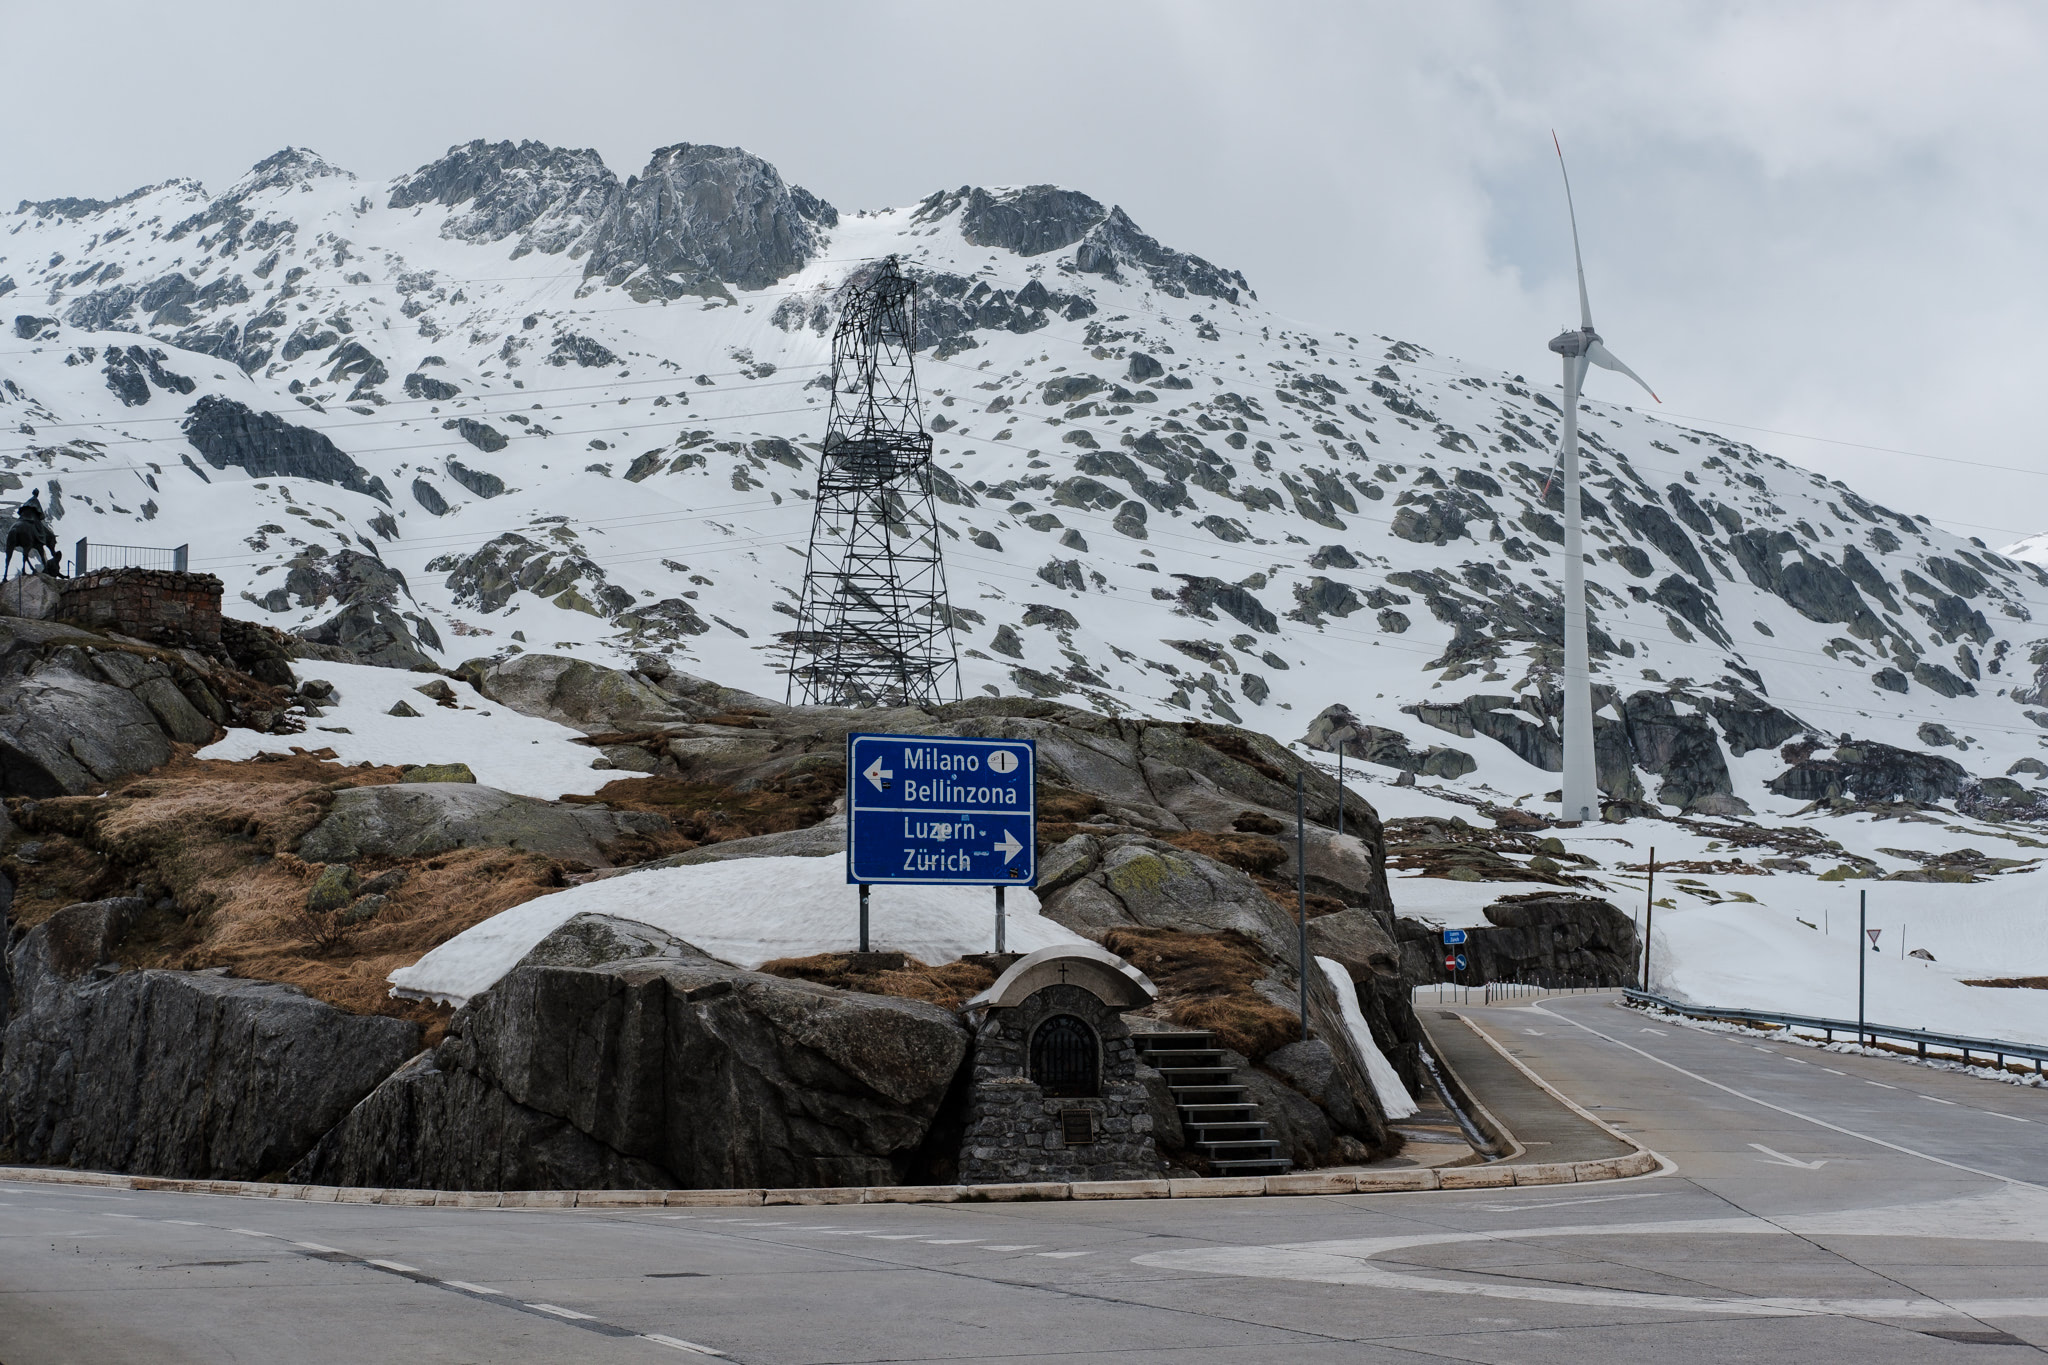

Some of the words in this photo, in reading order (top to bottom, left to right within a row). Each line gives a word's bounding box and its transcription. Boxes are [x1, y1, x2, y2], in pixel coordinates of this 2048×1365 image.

[904, 748, 979, 771] Milano
[904, 779, 1017, 804] Bellinzona
[904, 816, 975, 840] Luzern
[903, 848, 971, 872] Zürich
